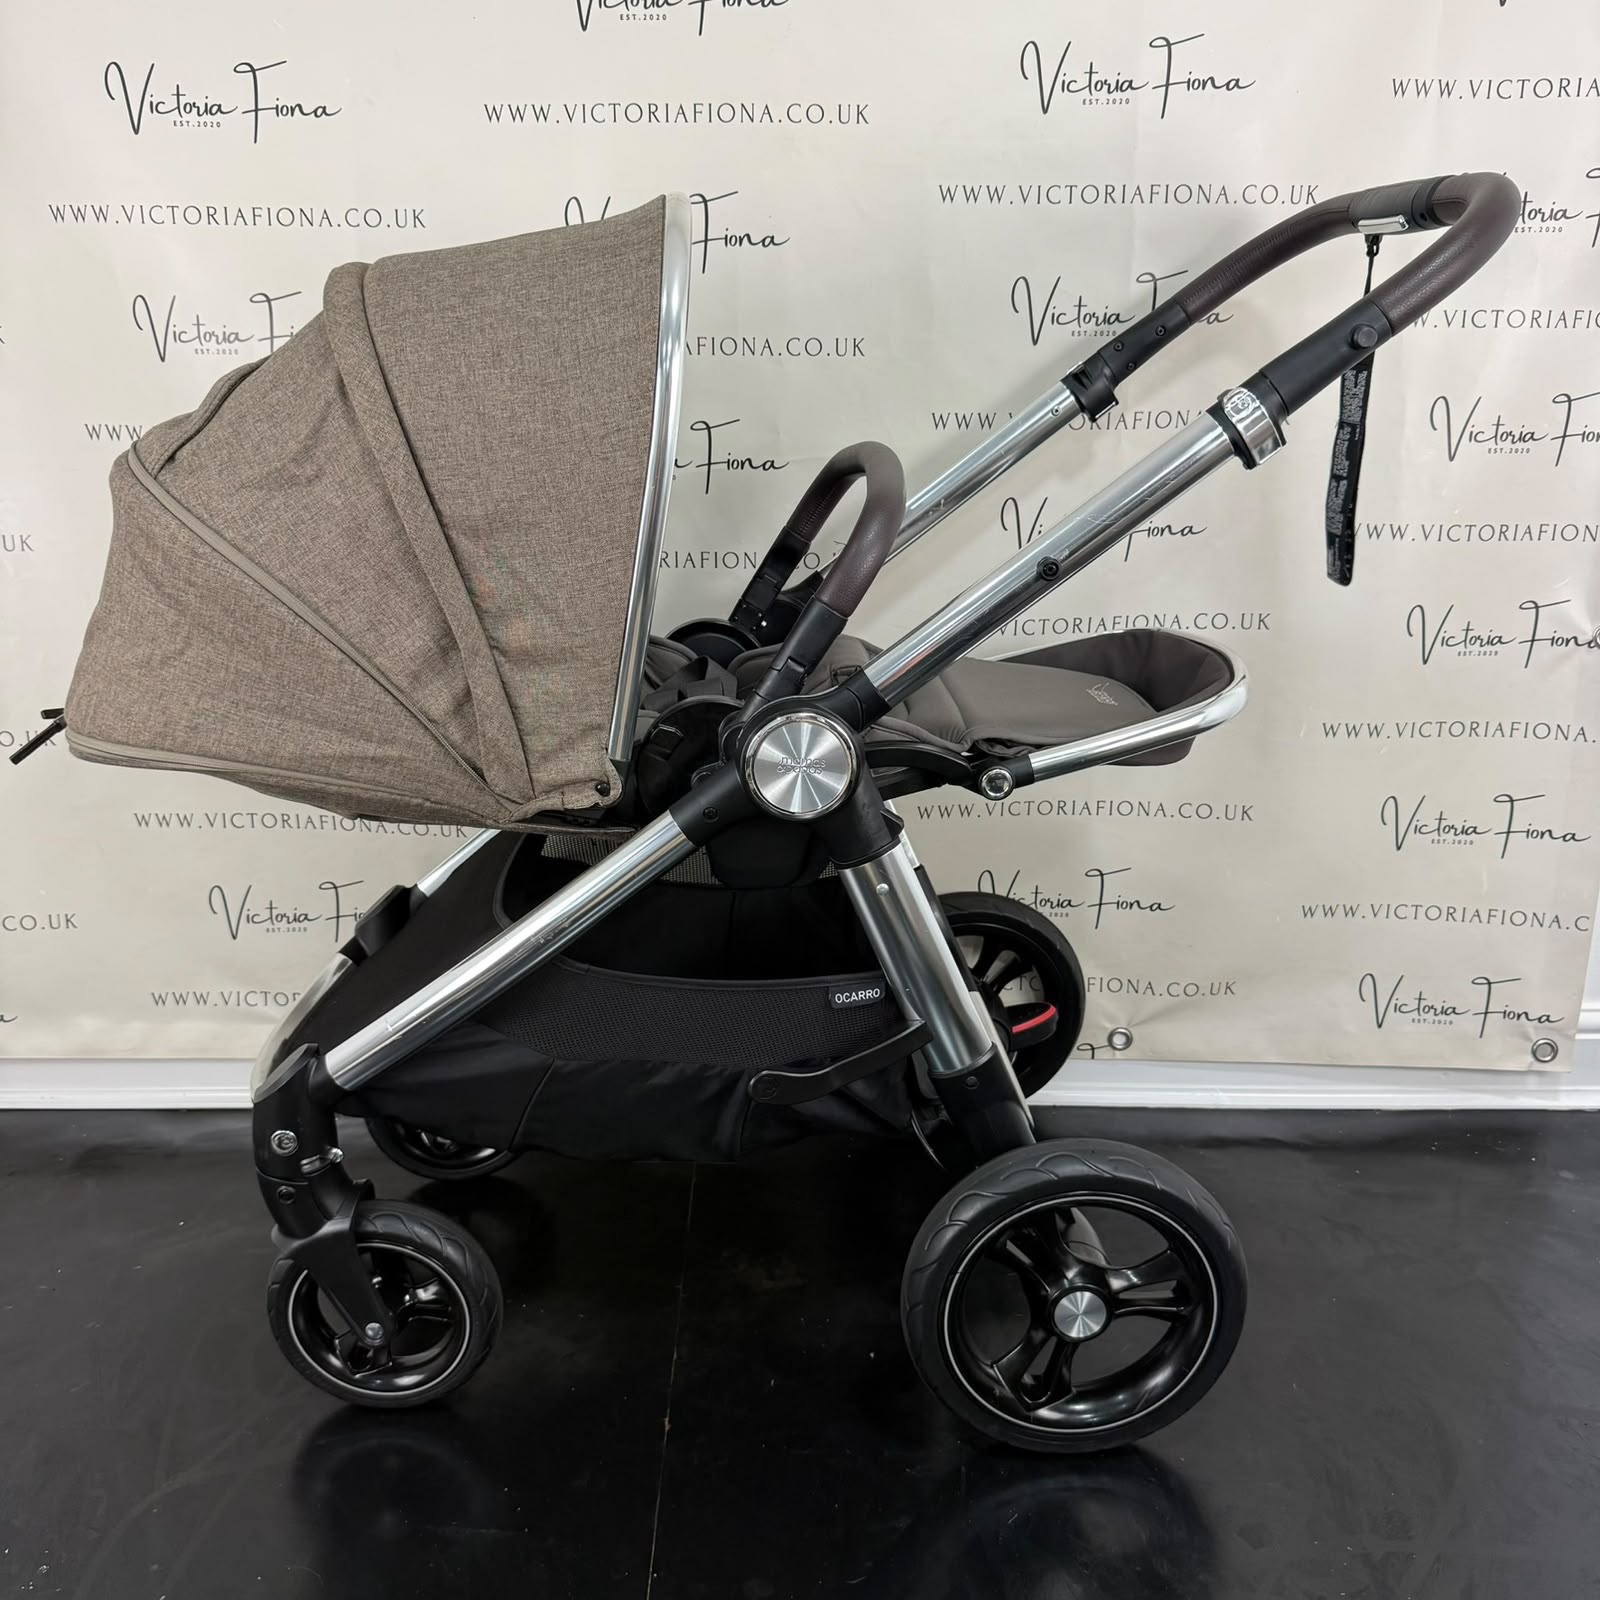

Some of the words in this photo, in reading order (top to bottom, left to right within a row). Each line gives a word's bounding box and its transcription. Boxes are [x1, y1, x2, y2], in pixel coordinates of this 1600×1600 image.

[104, 61, 238, 135] Victoria
[233, 60, 342, 144] Fiona
[1020, 41, 1149, 114] Victoria
[1149, 34, 1256, 118] Fiona
[173, 120, 221, 128] EST.2020
[484, 103, 869, 125] WWW.VICTORIAFIONA.CO.UK
[49, 204, 426, 229] WWW.VICTORIAFIONA.CO.UK
[938, 184, 1320, 205] WWW.VICTORIAFIONA.CO.UK
[689, 191, 790, 274] Fiona
[133, 295, 254, 362] Victoria
[1011, 276, 1135, 346] Victoria
[690, 419, 789, 494] Fiona
[1430, 395, 1549, 462] Victoria
[1407, 604, 1516, 665] Victoria
[917, 800, 1254, 821] WWW.VICTORIAFIONA.CO.UK
[1381, 795, 1492, 851] Victoria
[1493, 793, 1591, 859] Fiona
[209, 884, 322, 940] Victoria
[1085, 867, 1175, 929] Fiona
[835, 988, 880, 1003] OCARRO
[1359, 973, 1470, 1029] Victoria
[1471, 976, 1565, 1038] Fiona
